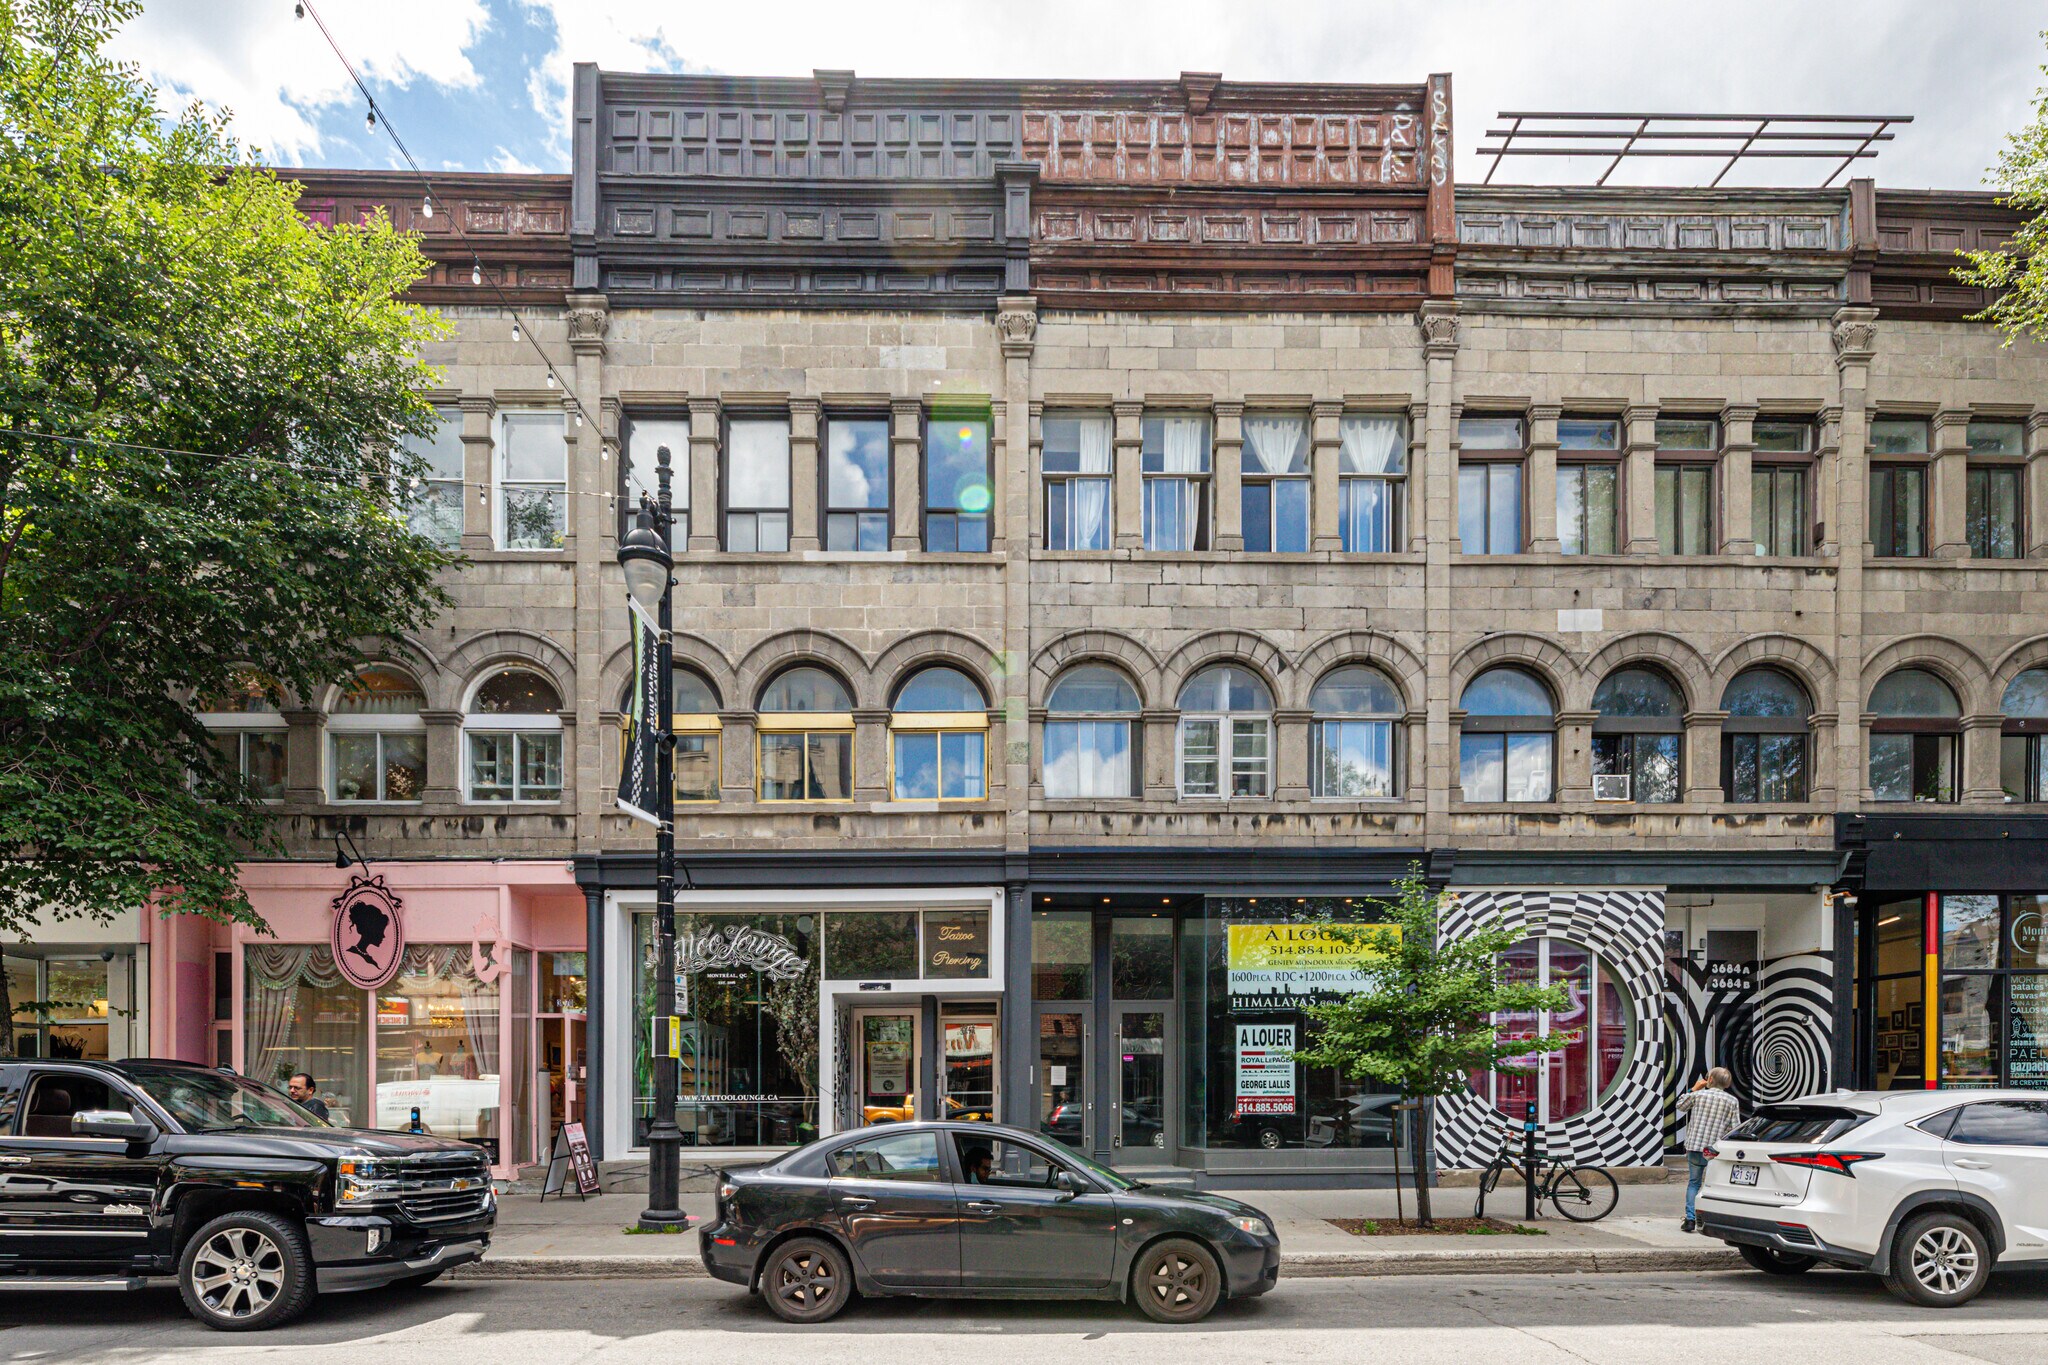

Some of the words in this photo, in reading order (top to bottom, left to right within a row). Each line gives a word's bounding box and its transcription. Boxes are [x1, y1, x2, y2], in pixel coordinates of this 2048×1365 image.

[938, 926, 975, 941] Tattoo
[1269, 945, 1361, 955] 514.884.1052
[932, 950, 982, 971] Piercing
[1711, 963, 1741, 974] 3684
[1742, 966, 1750, 975] A
[1275, 972, 1297, 982] RDC
[1711, 978, 1741, 988] 3684
[1743, 981, 1750, 989] B
[2010, 983, 2044, 993] patates
[2010, 990, 2039, 1000] bravas
[2010, 1006, 2040, 1014] CALLOS
[1240, 1028, 1249, 1046] A
[1252, 1028, 1292, 1046] LOUER
[1240, 1080, 1267, 1089] GEORGE
[1268, 1080, 1291, 1089] LALLIS
[1237, 1103, 1294, 1112] 514.885.5066
